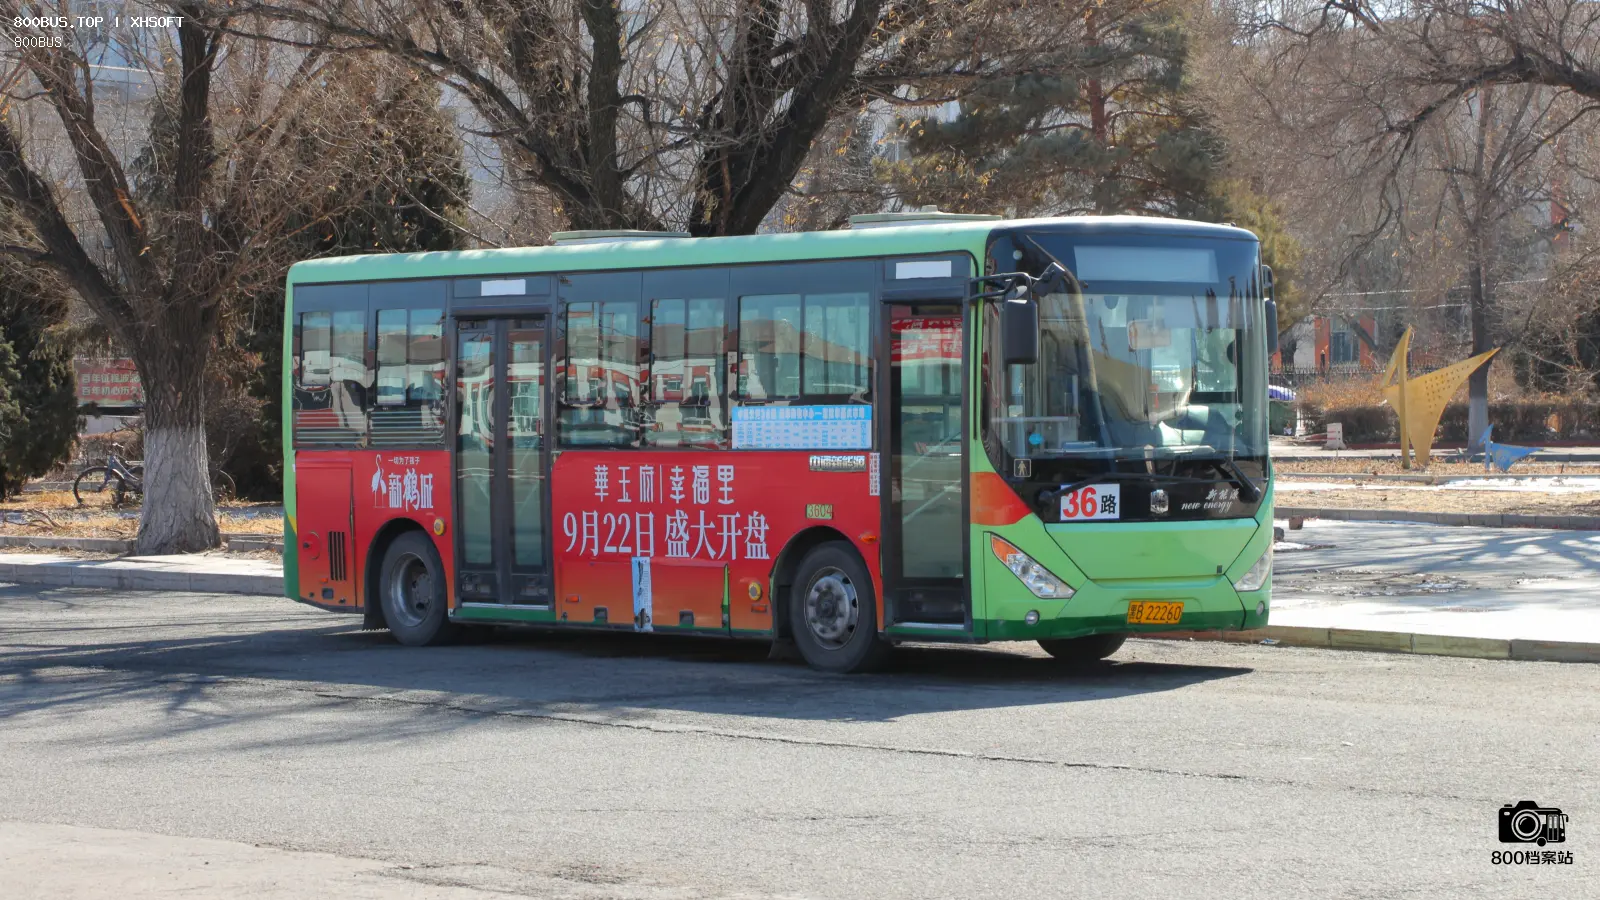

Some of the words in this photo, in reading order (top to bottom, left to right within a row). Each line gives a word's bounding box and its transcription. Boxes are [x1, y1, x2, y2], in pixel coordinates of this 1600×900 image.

[388, 468, 434, 512] 新鹤城
[1205, 487, 1240, 500] 新能源
[1063, 486, 1117, 518] 36路
[1181, 501, 1200, 511] new
[1202, 501, 1233, 513] energy
[807, 504, 832, 518] 3604
[563, 510, 655, 557] 9月22日
[664, 509, 770, 560] 盛大开盘
[1145, 605, 1182, 621] 22260
